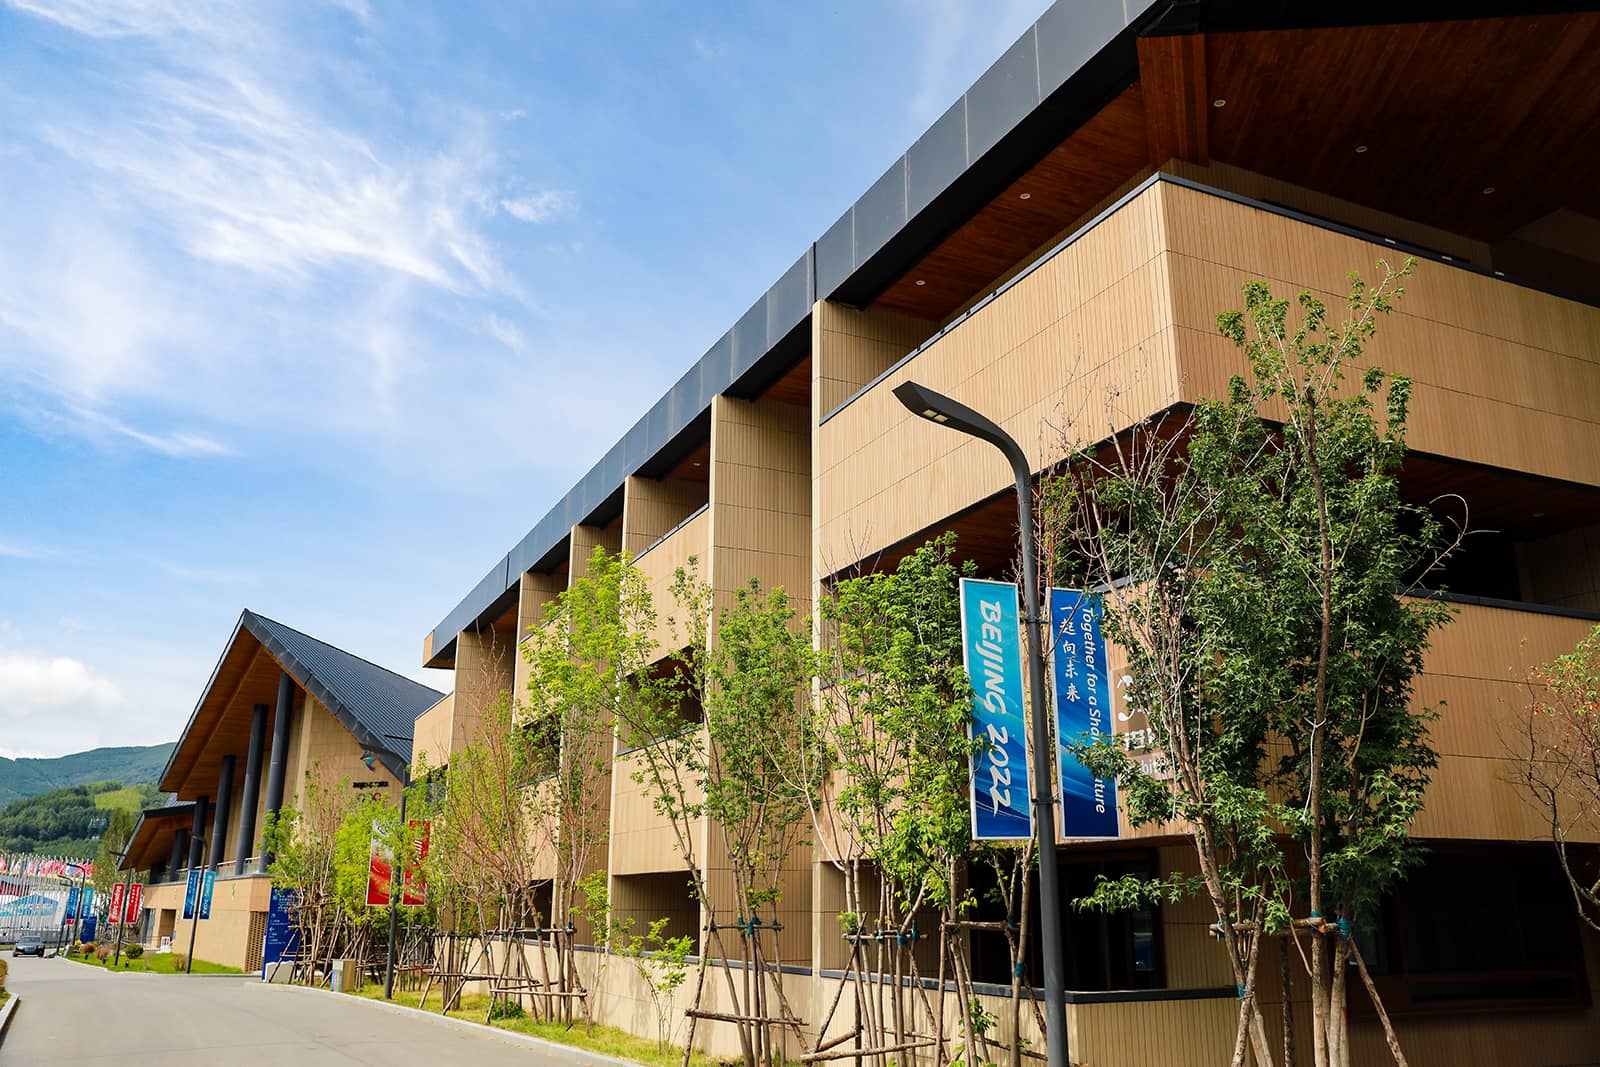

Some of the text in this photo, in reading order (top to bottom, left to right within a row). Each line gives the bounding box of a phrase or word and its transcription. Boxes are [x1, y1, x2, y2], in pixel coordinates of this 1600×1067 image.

[1060, 606, 1080, 702] 一起向未来
[1081, 607, 1097, 670] Together
[975, 600, 1011, 816] BEIJING 2022
[1087, 673, 1099, 694] for
[1088, 696, 1098, 706] a
